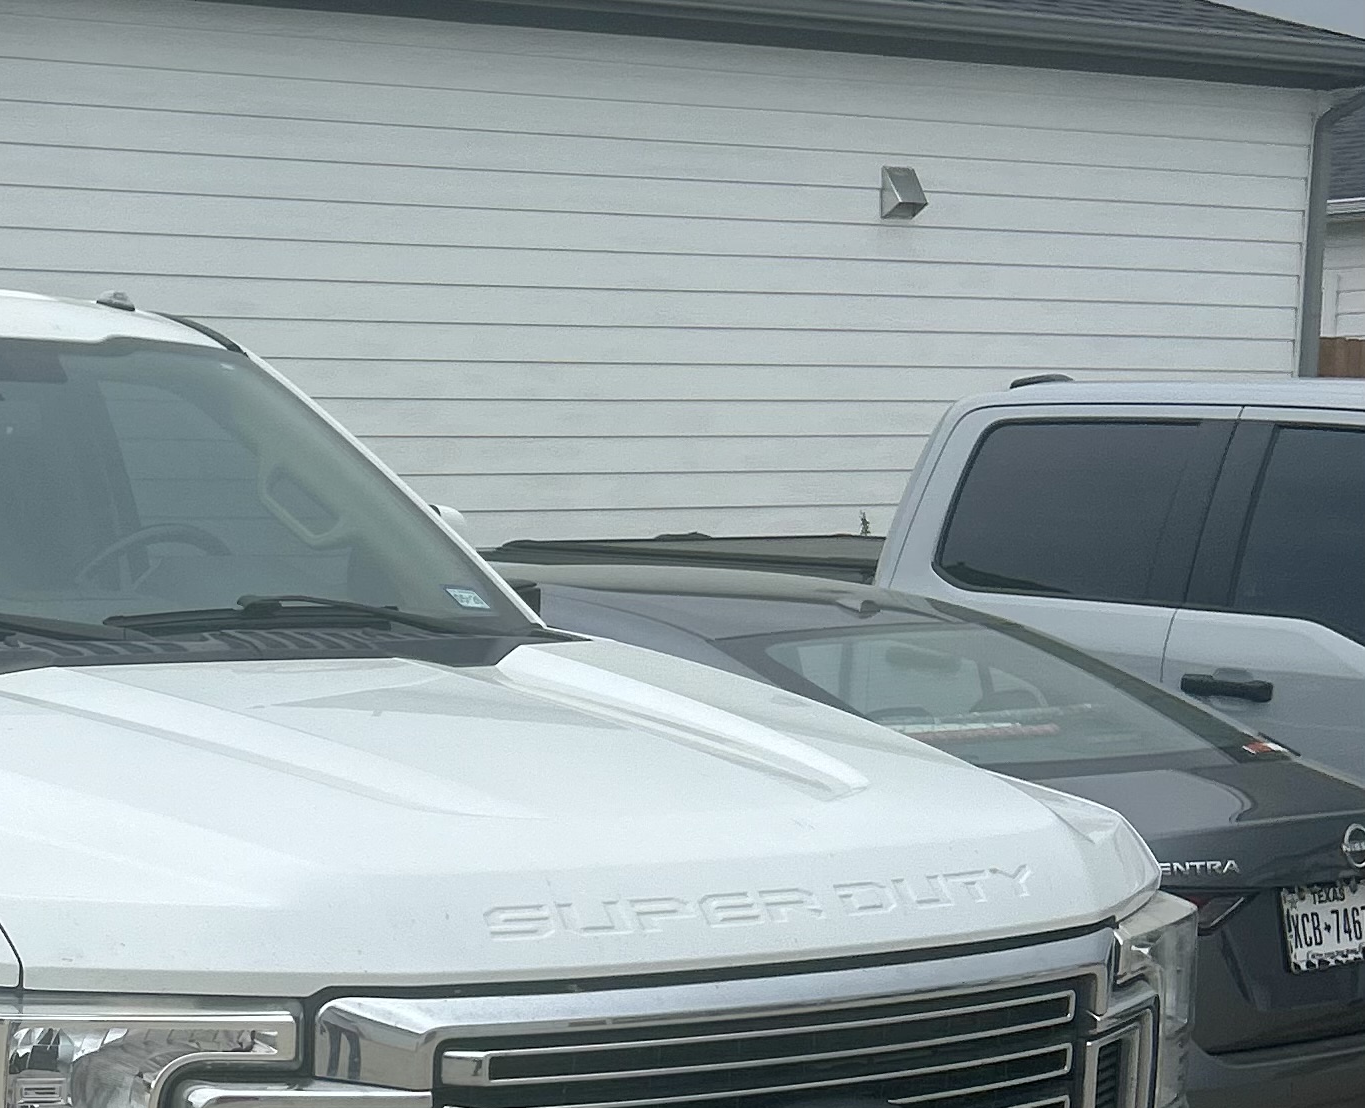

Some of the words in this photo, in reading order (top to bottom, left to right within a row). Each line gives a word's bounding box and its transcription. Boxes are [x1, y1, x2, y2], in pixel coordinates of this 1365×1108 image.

[1160, 860, 1240, 876] ENTRA
[483, 888, 826, 942] SUPER
[833, 864, 1031, 916] DUTY
[1311, 887, 1345, 905] TEXAS
[1291, 912, 1323, 949] XCB
